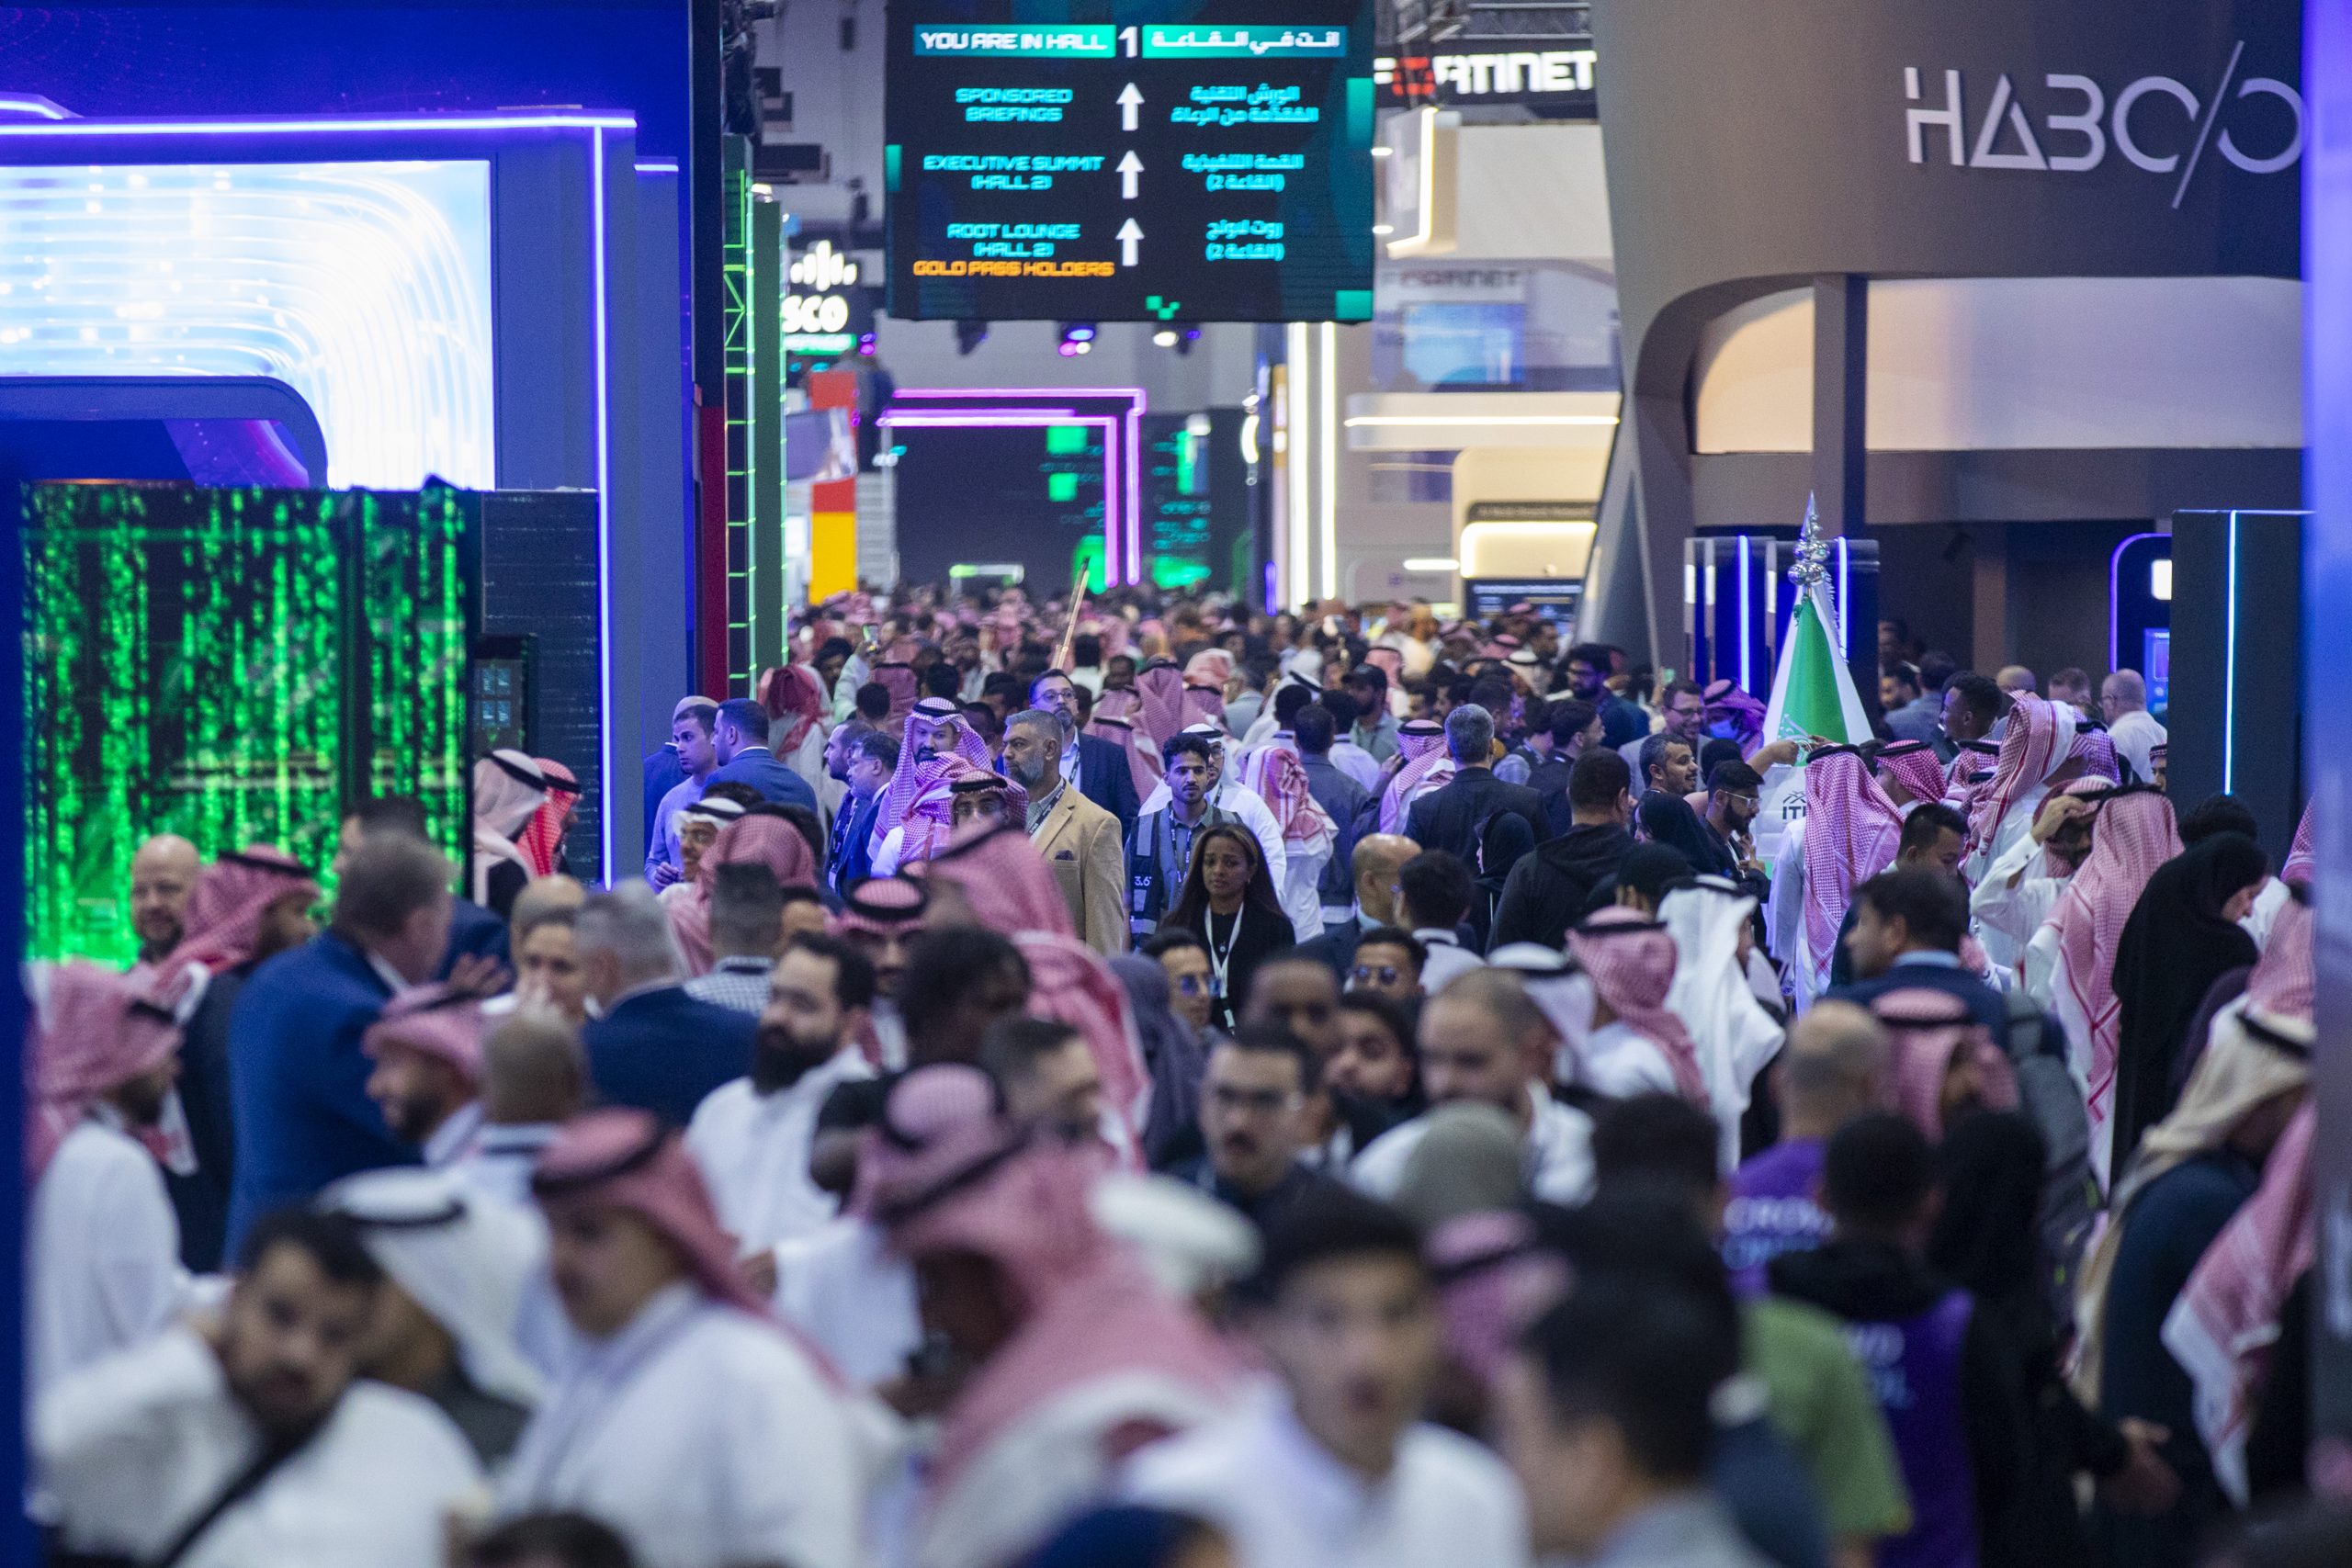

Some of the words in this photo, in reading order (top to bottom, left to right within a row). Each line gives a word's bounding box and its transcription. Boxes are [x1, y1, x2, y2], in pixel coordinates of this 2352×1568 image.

[921, 32, 968, 50] YOU
[971, 33, 1018, 50] ARE
[1020, 34, 1042, 50] IN
[1046, 34, 1108, 51] HALL
[1118, 26, 1138, 58] 1
[1249, 30, 1295, 55] في
[1374, 51, 1598, 96] FORTINET
[956, 88, 1073, 104] SPONSORED
[965, 107, 1063, 122] BRIEFINGS
[923, 155, 1031, 171] EXECUTIVE
[1032, 156, 1105, 172] SUMMIT
[1253, 154, 1305, 170] القمة
[946, 223, 1001, 239] ROOT
[1001, 223, 1081, 240] LOUNGE
[913, 261, 967, 276] GOLD
[967, 261, 1023, 277] PASS
[1023, 261, 1115, 277] HOLDERS
[780, 294, 849, 333] SCO
